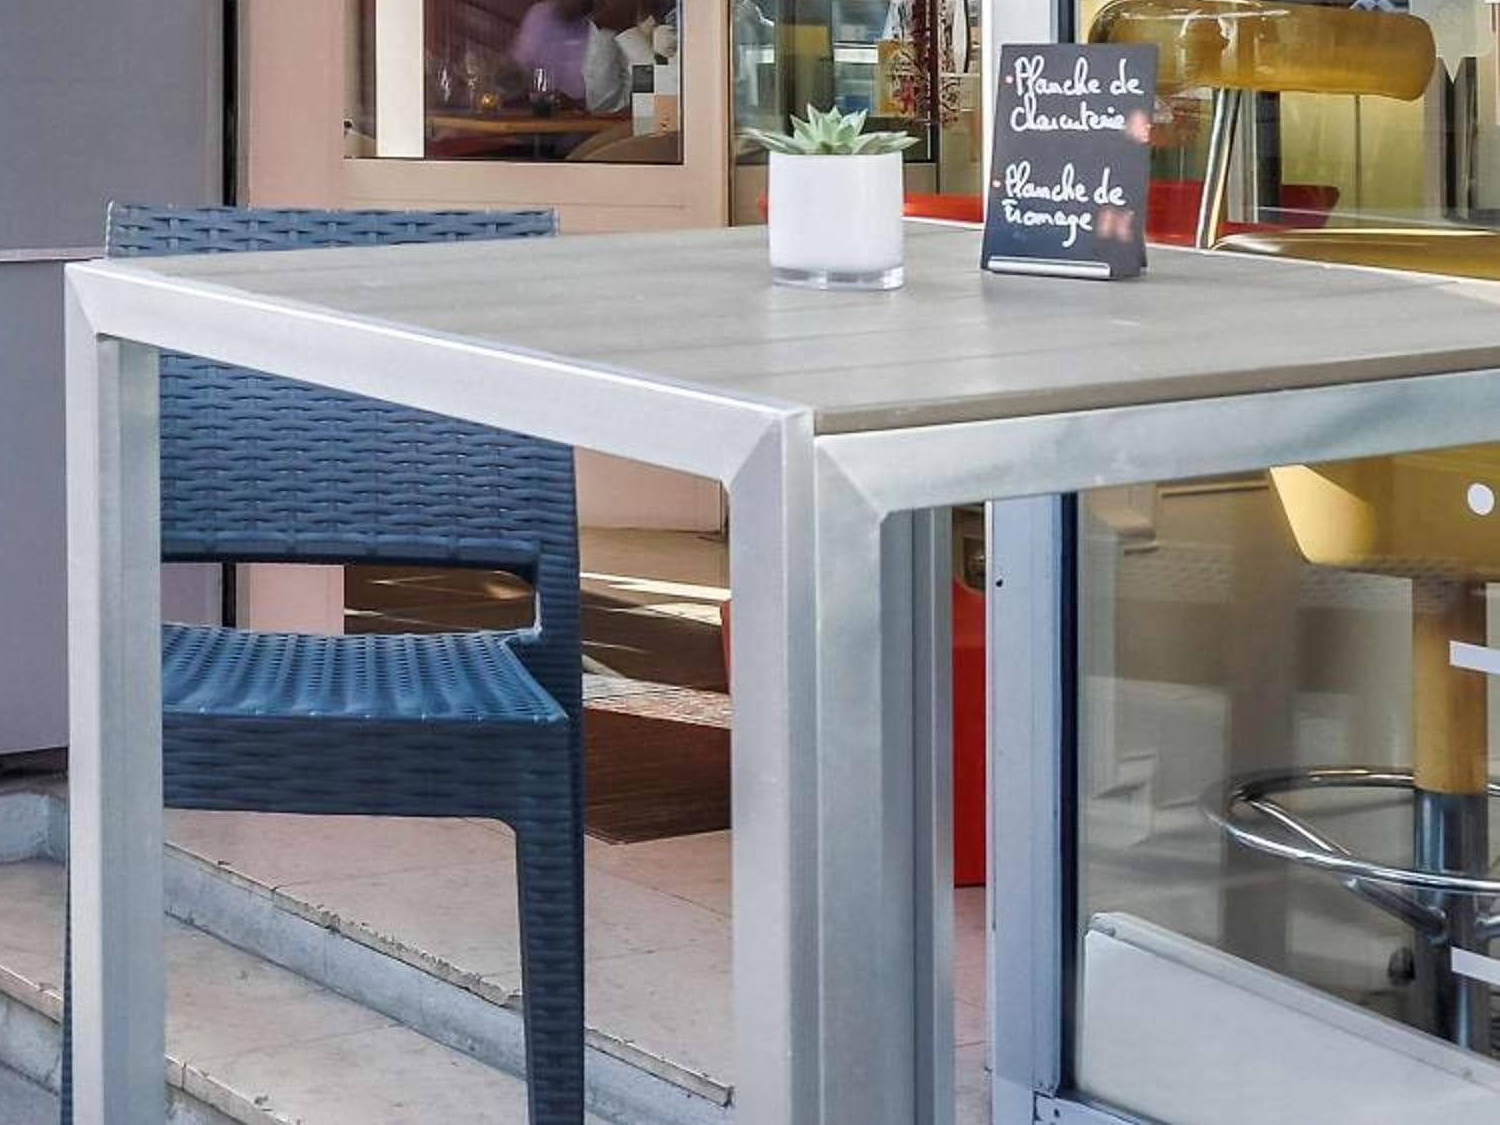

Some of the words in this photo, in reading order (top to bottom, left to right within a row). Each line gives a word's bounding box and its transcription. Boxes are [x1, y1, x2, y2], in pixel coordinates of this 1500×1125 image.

[1014, 55, 1101, 96] Planche
[1109, 58, 1145, 95] de
[1004, 161, 1089, 203] Planche
[1093, 167, 1126, 206] de
[1001, 199, 1093, 248] Fromage
